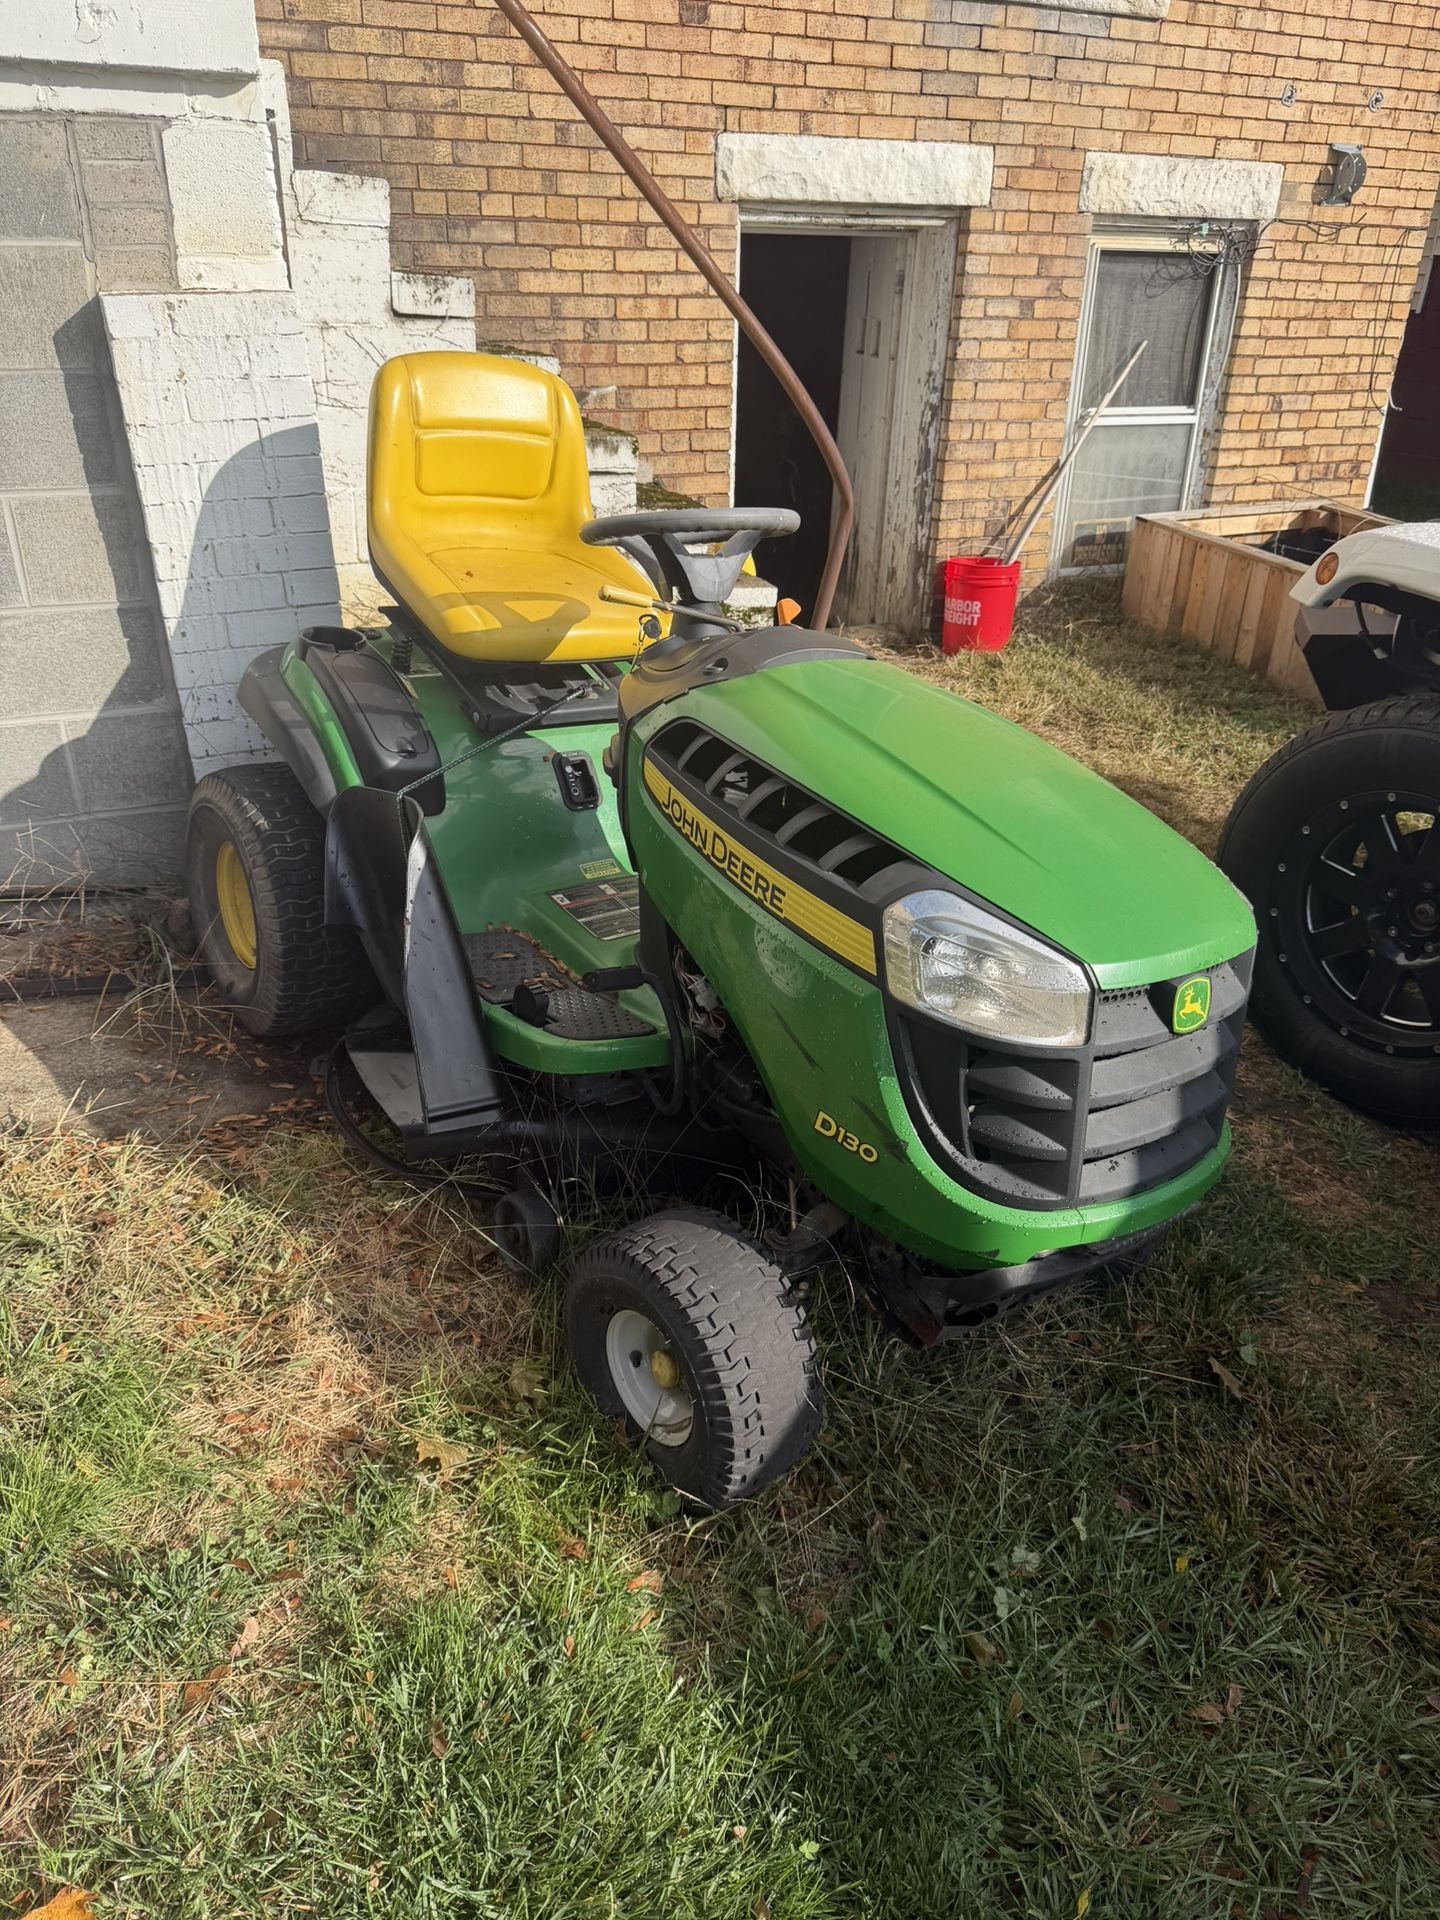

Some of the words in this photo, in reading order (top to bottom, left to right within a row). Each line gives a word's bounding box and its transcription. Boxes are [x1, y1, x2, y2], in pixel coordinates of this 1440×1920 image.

[661, 786, 708, 851] JOHN
[711, 831, 786, 914] DEERE
[813, 1110, 879, 1163] D130
